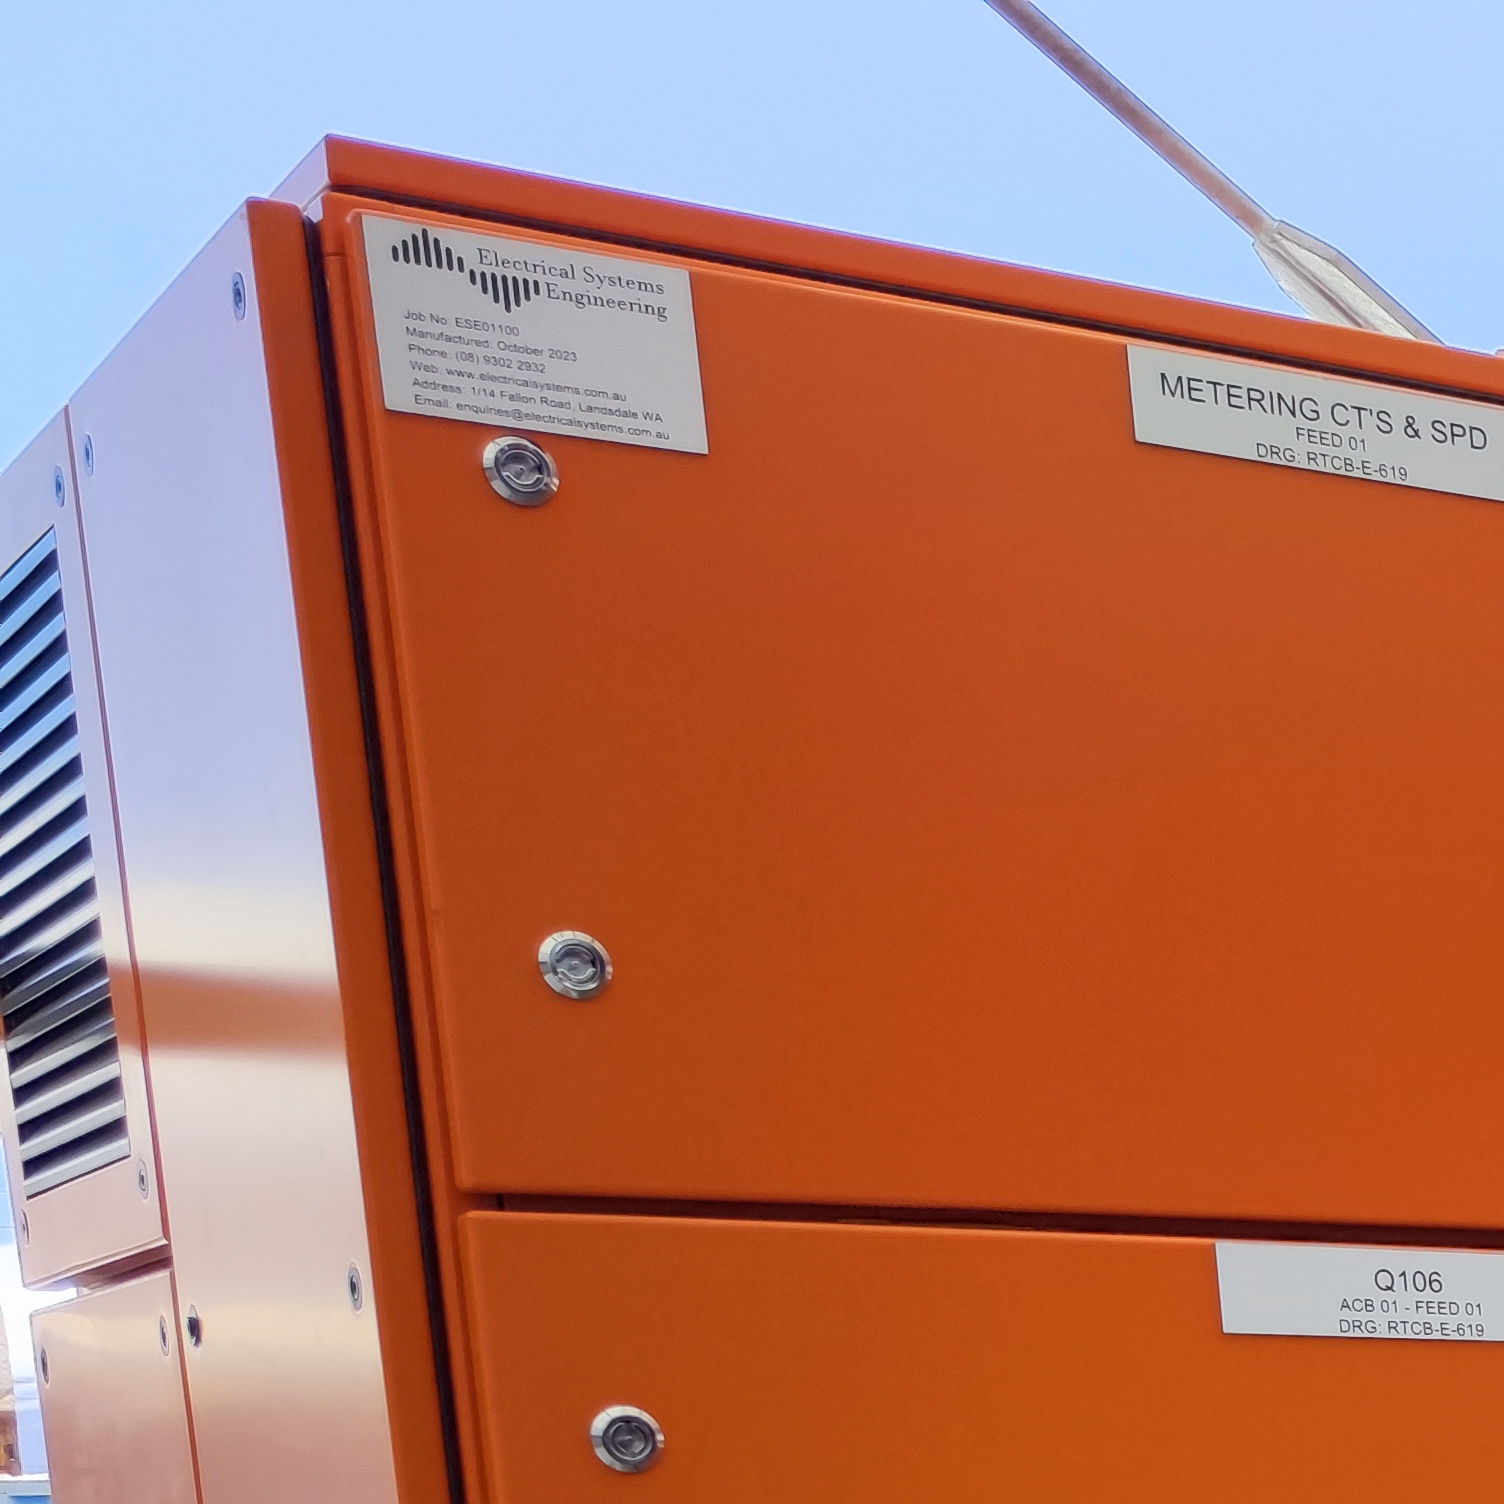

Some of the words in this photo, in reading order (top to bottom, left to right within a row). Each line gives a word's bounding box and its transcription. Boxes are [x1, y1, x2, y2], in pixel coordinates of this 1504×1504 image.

[477, 247, 576, 281] Electrical
[583, 267, 665, 295] Systems
[546, 283, 669, 322] Engineering
[404, 309, 426, 322] Job
[455, 318, 520, 337] ESE01100
[406, 327, 493, 350] Manufactured:
[497, 341, 545, 359] October
[548, 349, 578, 362] 2023
[408, 345, 452, 360] Phone:
[455, 352, 479, 366] (08)
[483, 354, 513, 369] 9302
[517, 358, 546, 374] 2932
[445, 367, 627, 402] www.electricalsystems.com.au
[412, 378, 467, 396] Address:
[471, 387, 495, 399] 1/14
[500, 391, 536, 404] Fallon
[578, 402, 638, 420] Landsdale
[642, 411, 663, 424] WA
[414, 394, 452, 410] Email:
[1159, 371, 1321, 421] METERING
[1330, 403, 1394, 435] CT'S
[1404, 415, 1422, 439] &
[1431, 419, 1488, 450] SPD
[1296, 427, 1343, 448] FEED
[1348, 437, 1367, 452] 01
[1256, 442, 1301, 464] DRG:
[1307, 452, 1408, 482] RTCB-E-619
[1374, 1268, 1443, 1294] Q106
[1339, 1299, 1375, 1313] ACB
[1380, 1300, 1399, 1313] 01
[1415, 1300, 1460, 1315] FEED
[1464, 1303, 1482, 1316] 01
[1339, 1319, 1382, 1334] DRG:
[1387, 1321, 1485, 1337] RTCB-E-619
